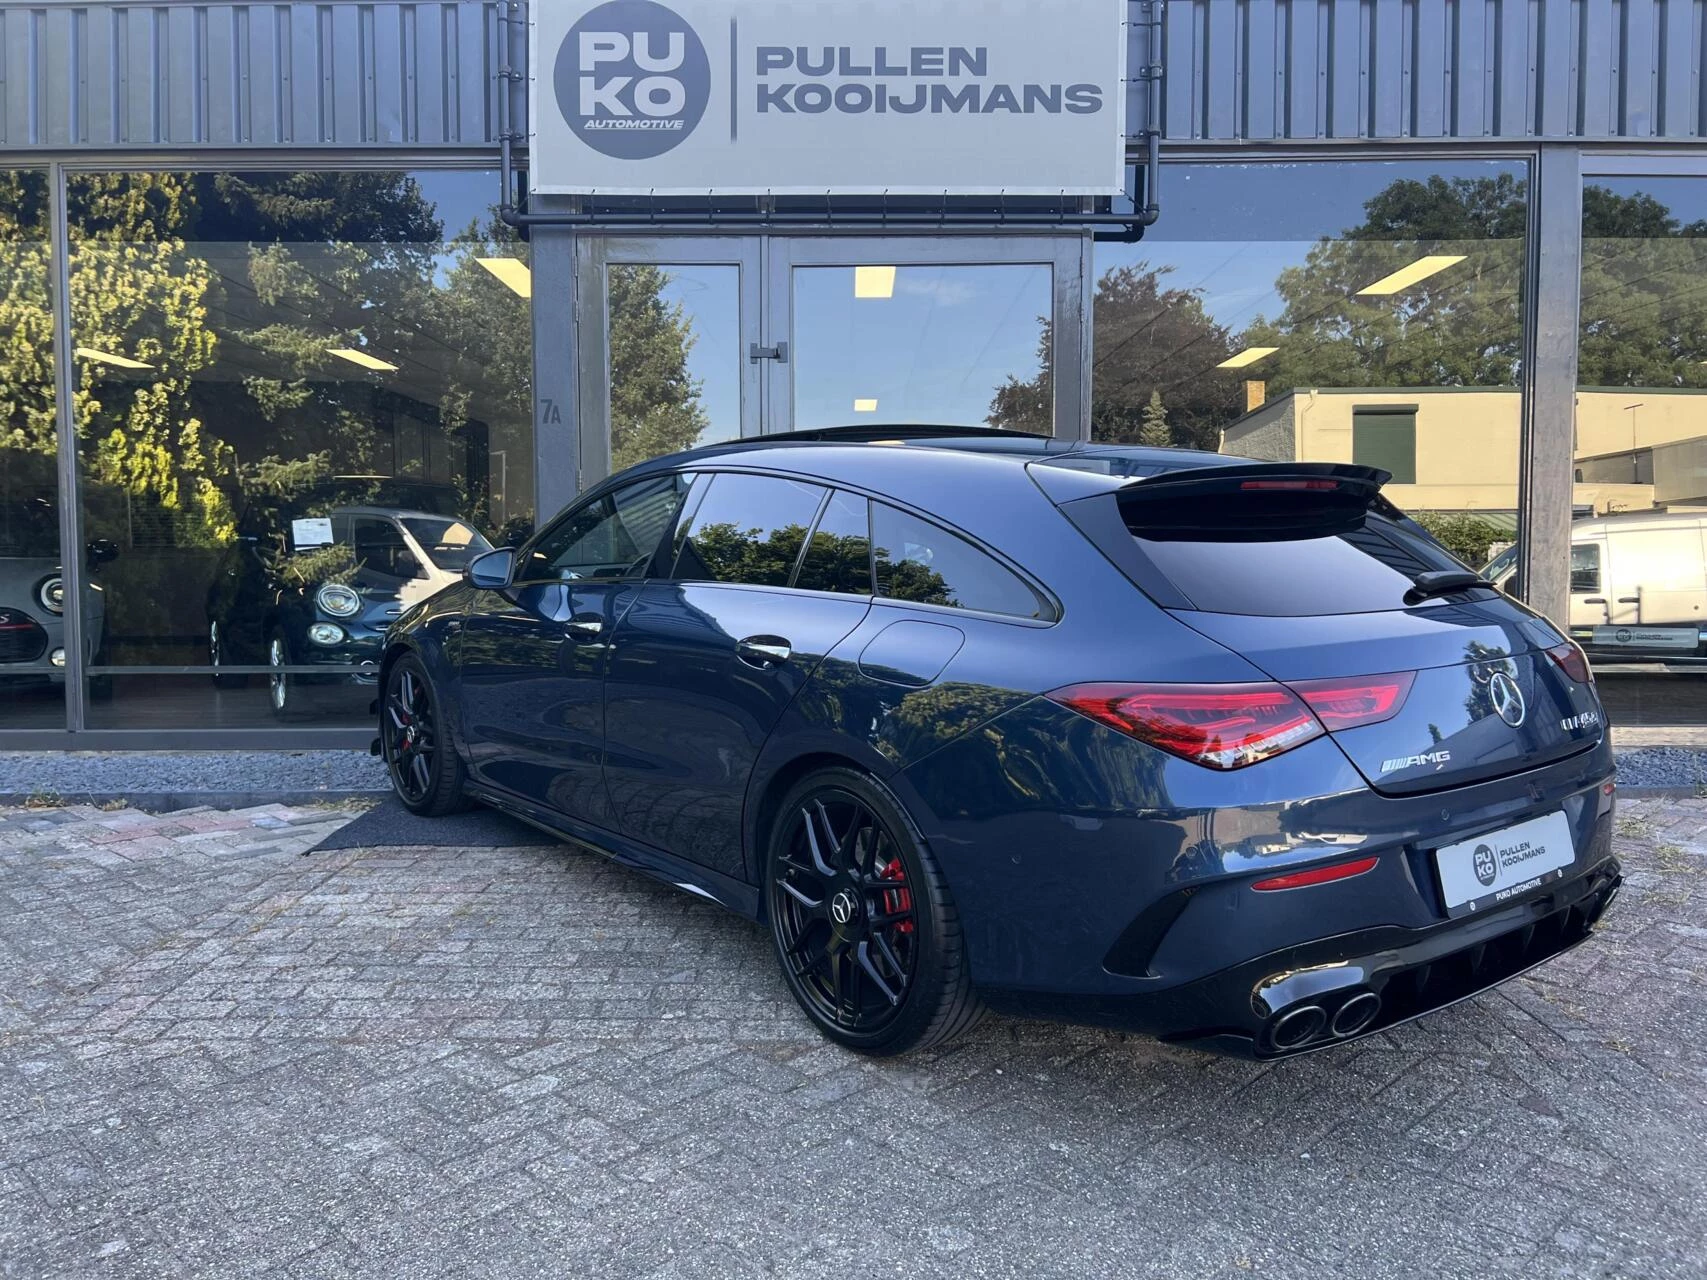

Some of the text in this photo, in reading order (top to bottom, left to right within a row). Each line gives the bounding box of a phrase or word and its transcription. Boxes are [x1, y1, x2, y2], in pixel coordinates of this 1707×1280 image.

[579, 32, 685, 71] PU
[756, 47, 987, 76] PULLEN
[579, 77, 685, 116] KO
[756, 84, 1102, 113] KOOIJMANS
[584, 120, 684, 129] AUTOMOTIVE
[540, 399, 561, 424] 7A
[1405, 750, 1451, 767] AMG
[1475, 850, 1491, 865] PU
[1500, 841, 1530, 858] PULLEN
[1502, 846, 1546, 867] KOOIJMANS
[1477, 862, 1494, 877] KO
[1511, 878, 1542, 895] AUTOMOTIVE
